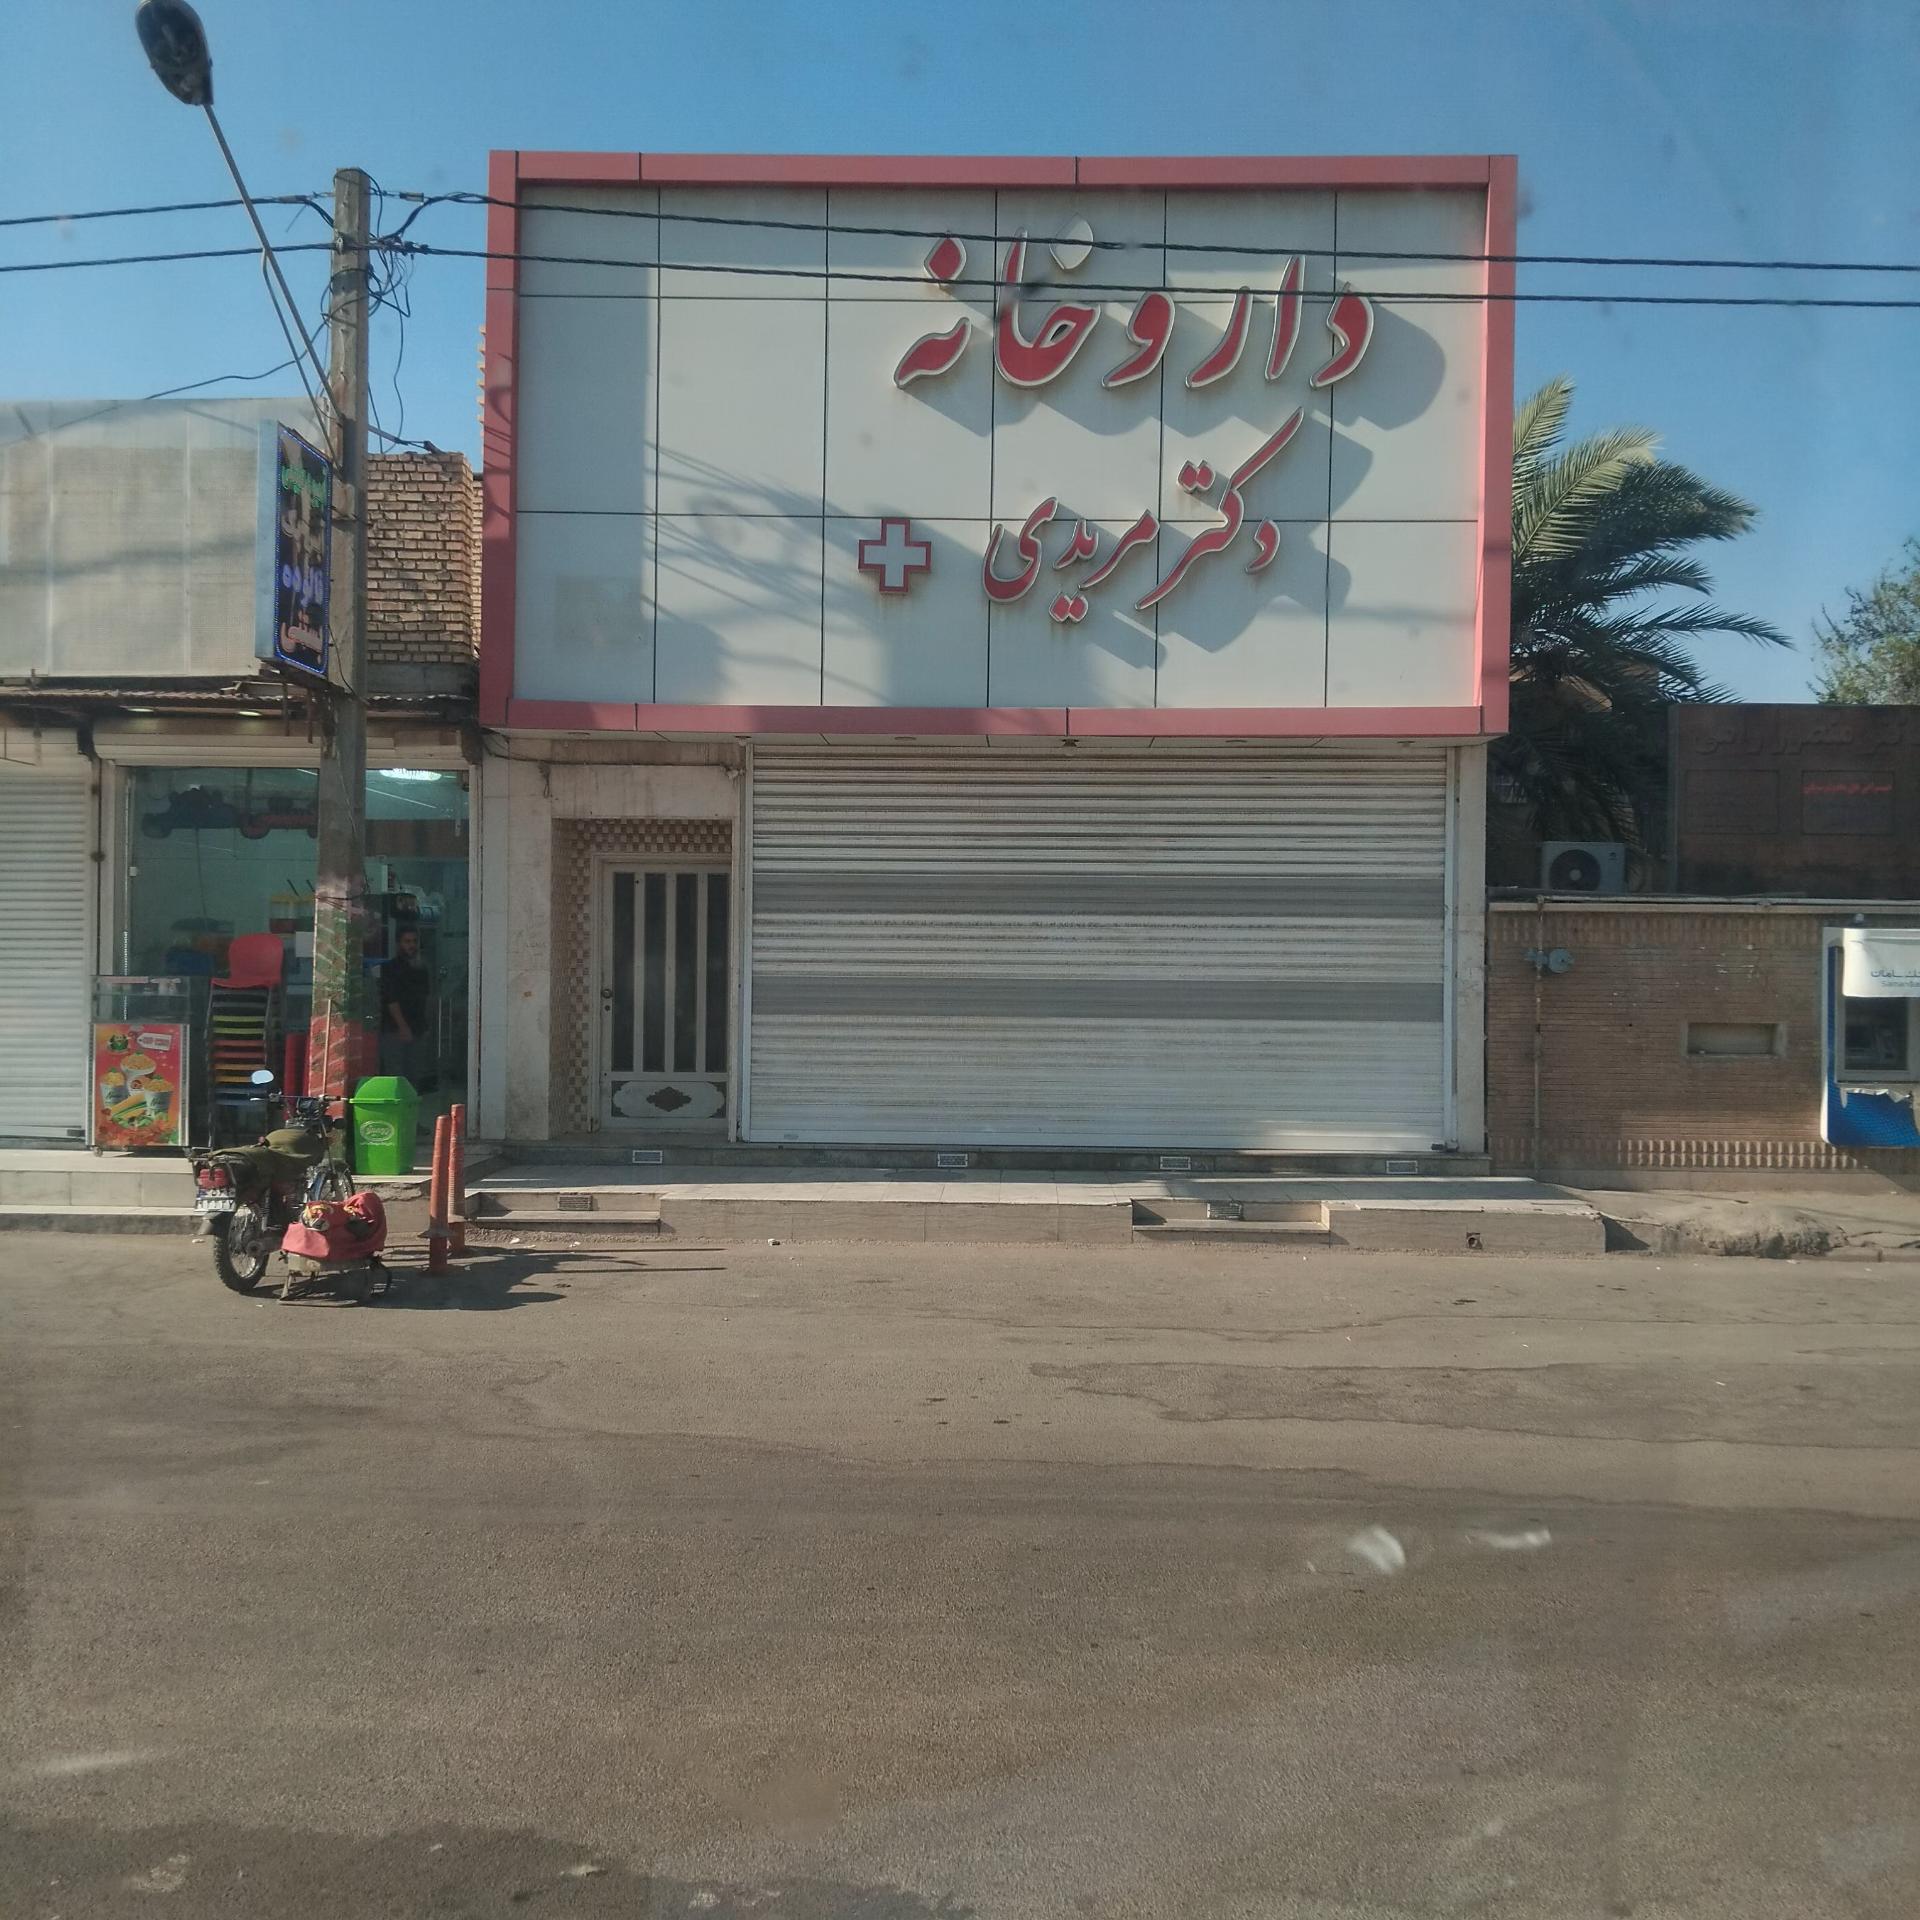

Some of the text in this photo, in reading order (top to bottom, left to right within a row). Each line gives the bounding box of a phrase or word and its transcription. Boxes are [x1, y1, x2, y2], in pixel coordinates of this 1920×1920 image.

[893, 213, 1375, 388] داروخانه
[981, 405, 1305, 623] دکتر مریدی
